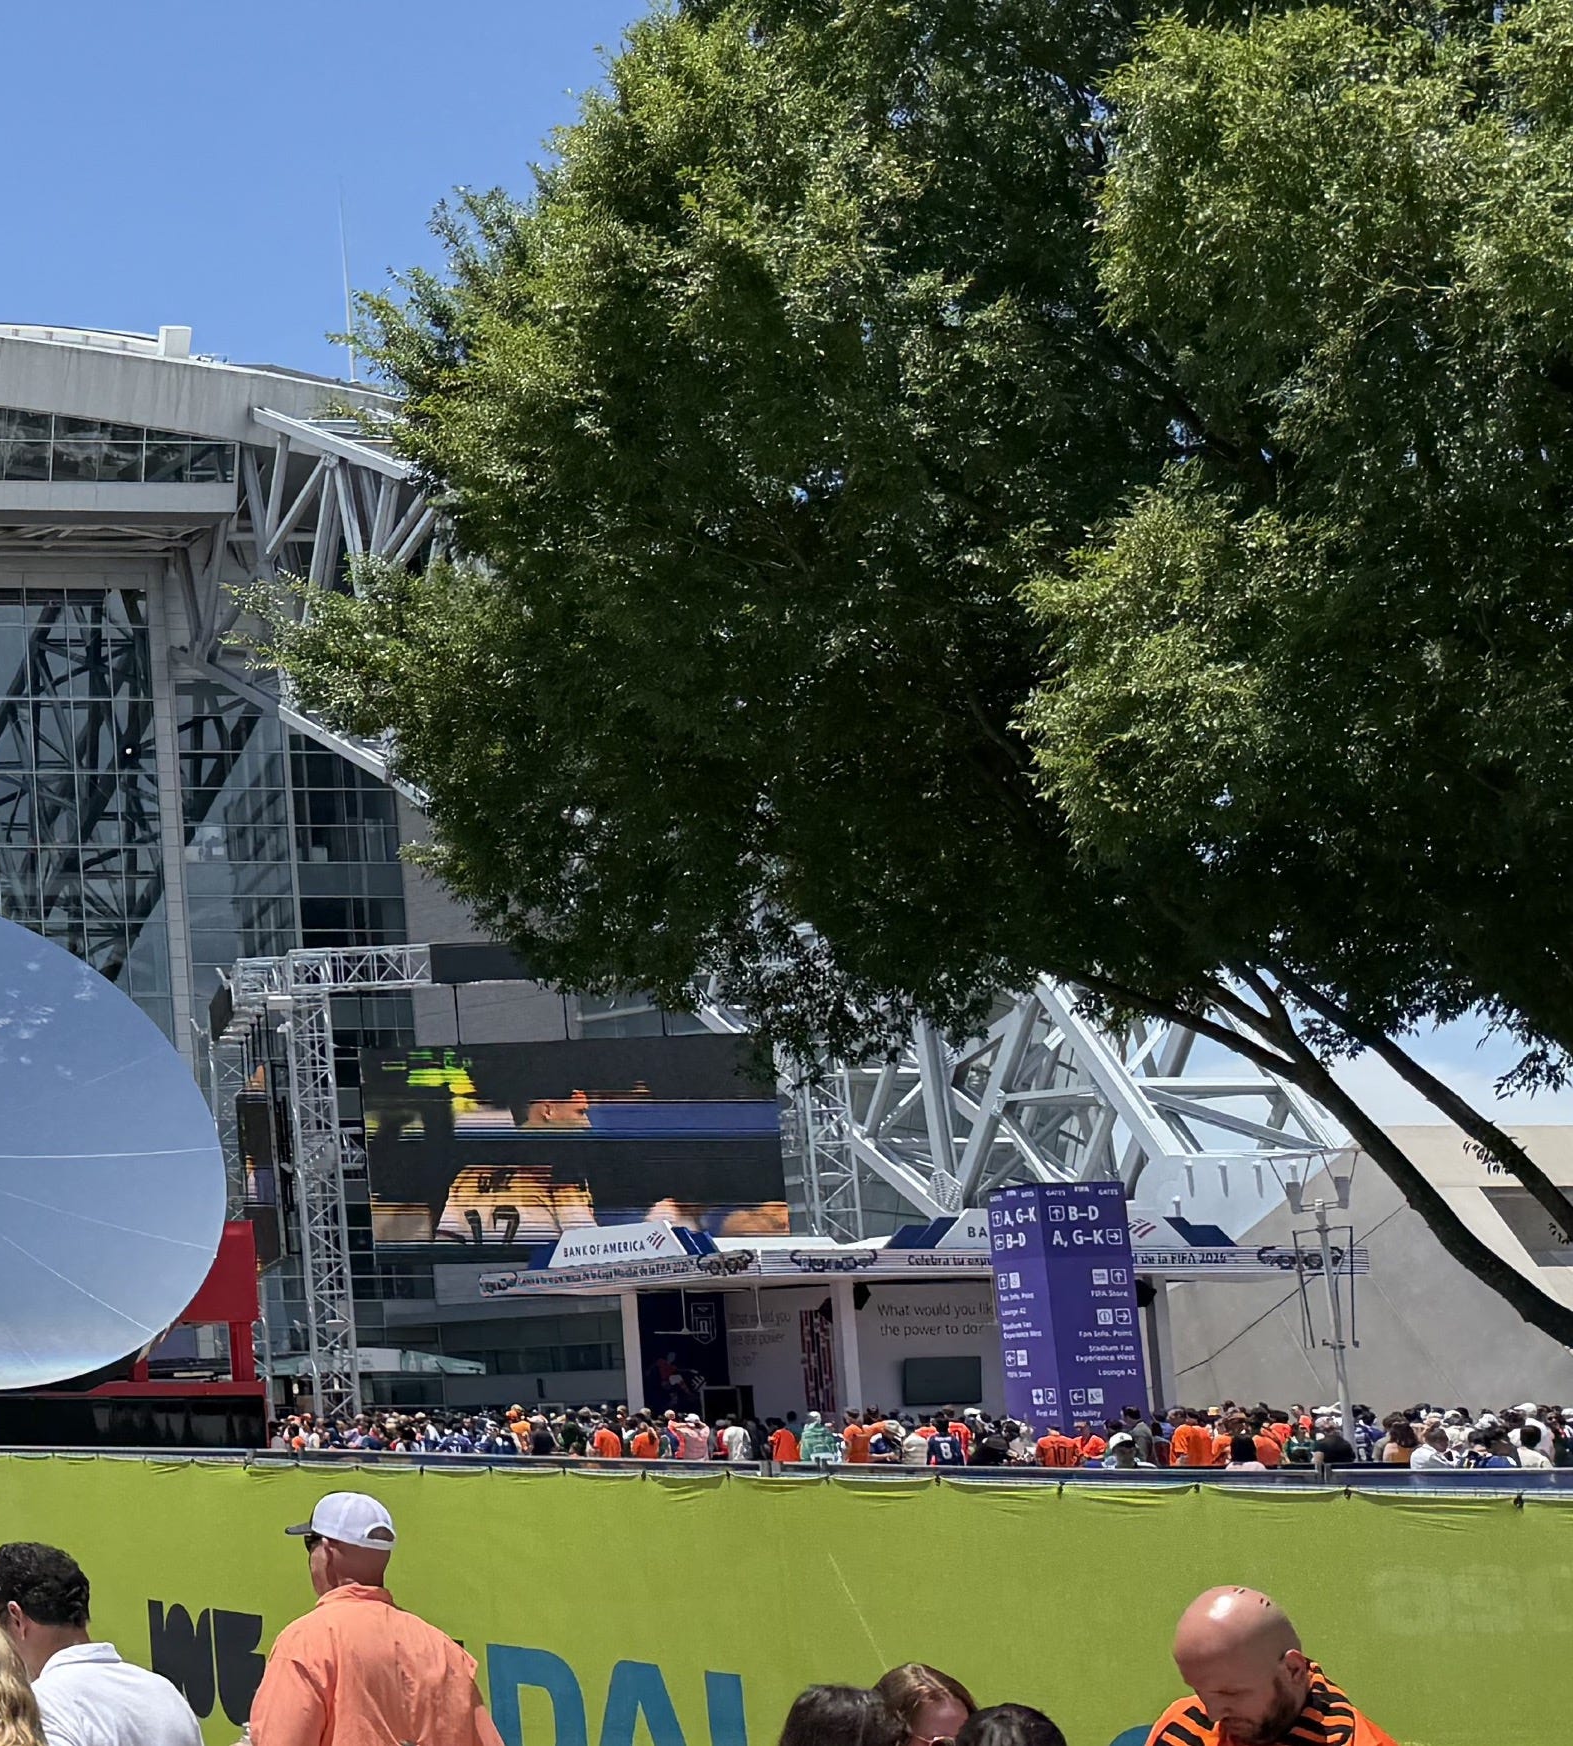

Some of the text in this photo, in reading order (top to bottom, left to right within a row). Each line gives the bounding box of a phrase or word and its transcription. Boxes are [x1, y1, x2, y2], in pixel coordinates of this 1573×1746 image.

[1004, 1210, 1014, 1226] A,
[1053, 1230, 1068, 1247] A,
[563, 1240, 646, 1258] BANK OF AMERICA
[1171, 1253, 1196, 1264] FIFA
[878, 1304, 910, 1317] What
[913, 1302, 951, 1317] would
[954, 1305, 976, 1319] you
[880, 1323, 900, 1337] the
[904, 1324, 941, 1340] power
[945, 1324, 959, 1335] to
[1075, 1354, 1115, 1363] Experience
[1098, 1369, 1125, 1377] Lounge
[1072, 1410, 1101, 1419] Mobility
[939, 1442, 952, 1461] 8
